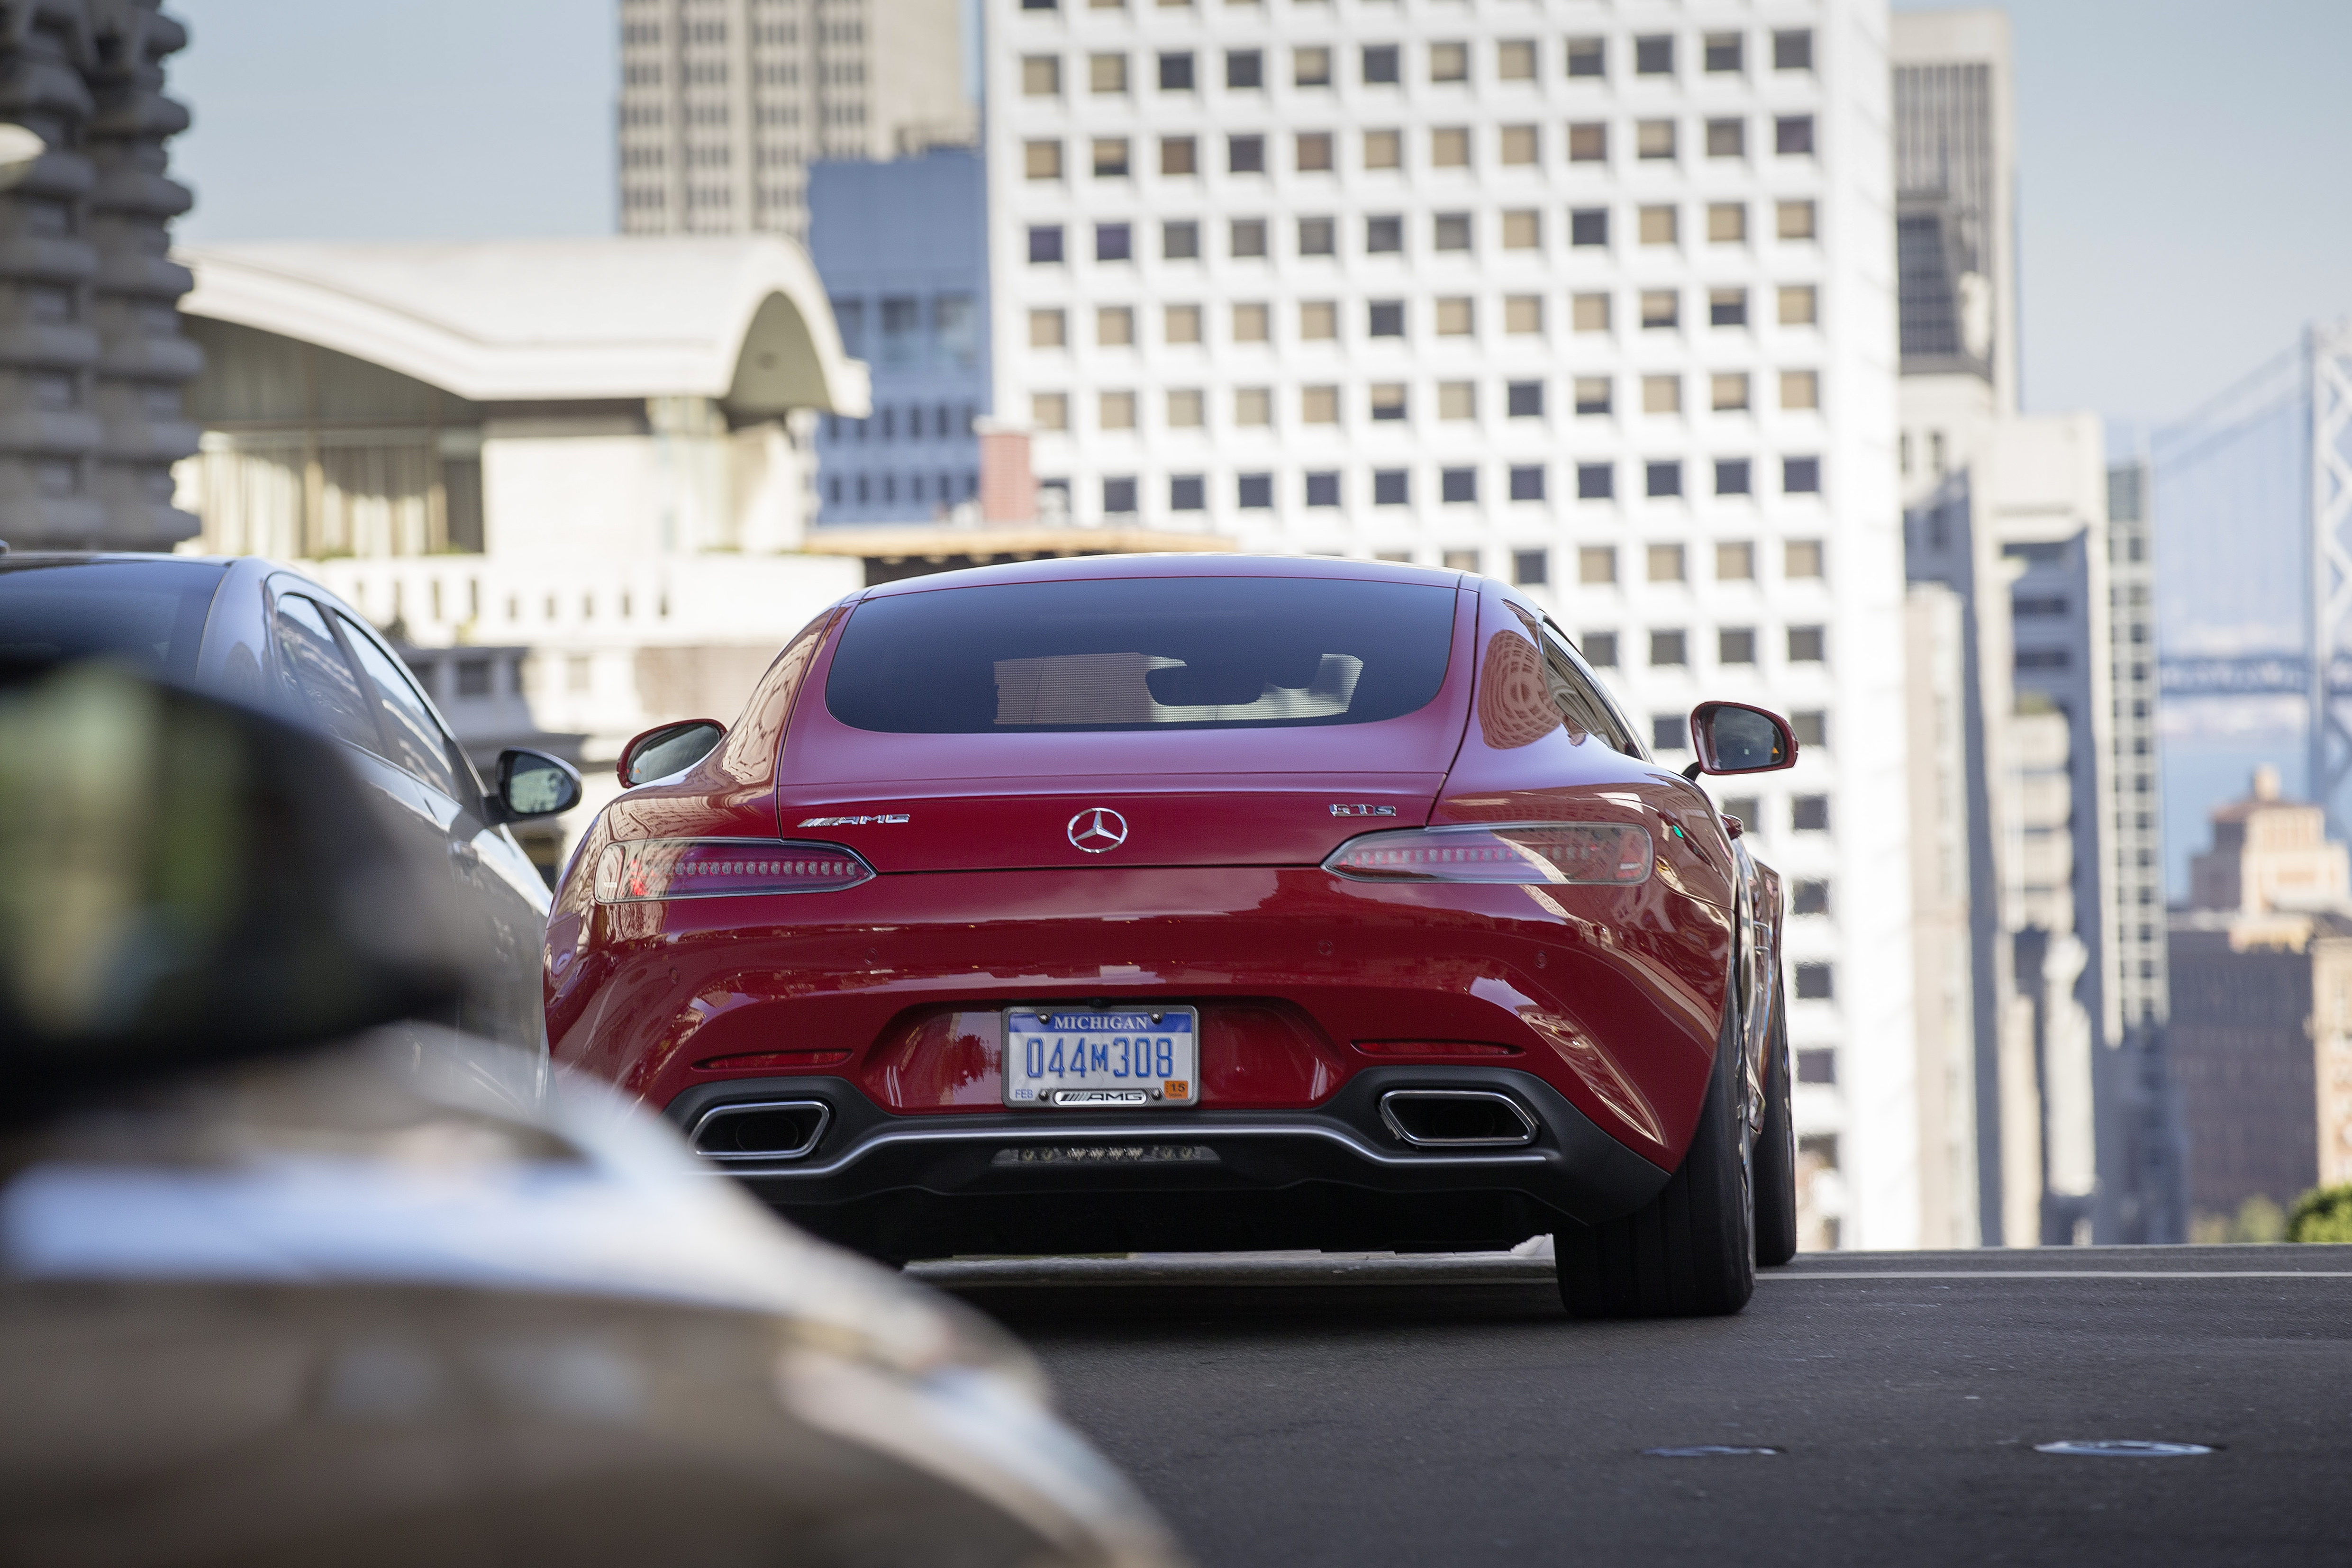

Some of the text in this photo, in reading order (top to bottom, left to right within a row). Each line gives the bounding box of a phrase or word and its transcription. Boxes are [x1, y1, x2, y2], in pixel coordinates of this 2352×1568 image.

[828, 814, 910, 826] AMG
[1055, 1016, 1148, 1030] MICHIGAN
[1027, 1037, 1173, 1078] 044M308
[1016, 1089, 1034, 1098] FEB
[1171, 1083, 1186, 1093] 15
[1088, 1093, 1142, 1101] AMG
